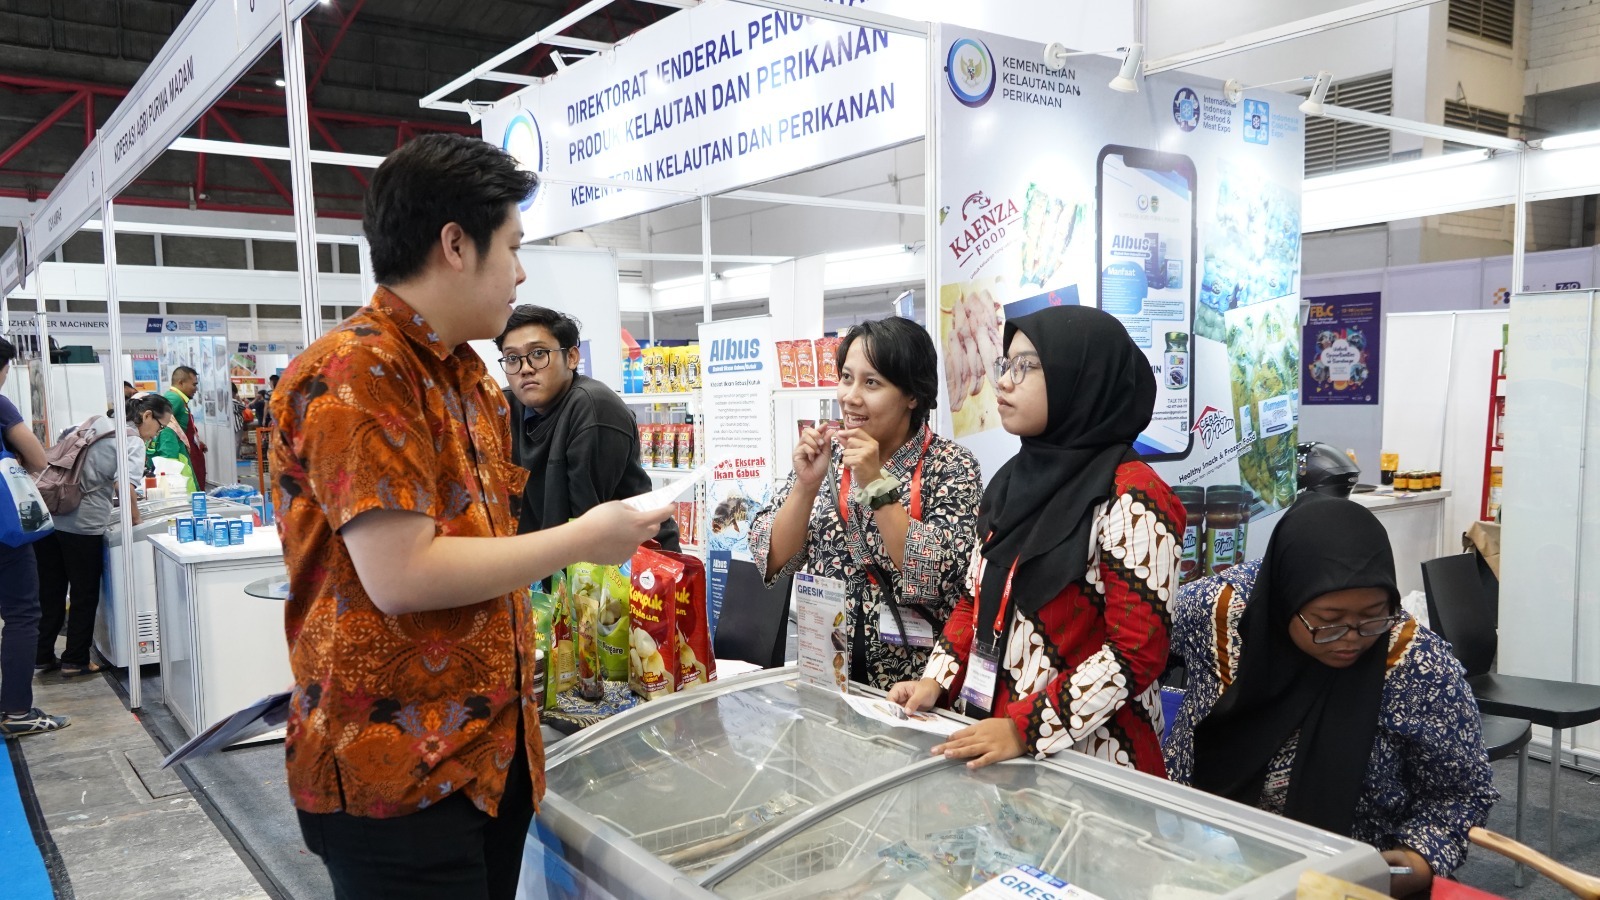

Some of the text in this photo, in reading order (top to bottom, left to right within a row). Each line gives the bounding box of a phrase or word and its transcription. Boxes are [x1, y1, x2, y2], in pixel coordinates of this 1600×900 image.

[569, 27, 888, 164] PRODUK KELAUTAN DAN PERIKANAN
[1002, 72, 1080, 96] KELAUTAN DAN
[113, 124, 136, 164] KOPERASI
[137, 109, 148, 140] AGRI
[169, 54, 194, 102] MADANI
[568, 69, 648, 127] DIREKTORAT
[1002, 88, 1062, 109] PERIKANAN
[1203, 103, 1232, 116] Indonesia
[1203, 112, 1226, 124] Seafood
[1203, 121, 1231, 133] Meat Expo
[657, 136, 732, 180] KELAUTAN
[738, 124, 772, 154] DAN
[778, 82, 896, 145] PERIKANAN
[949, 199, 1018, 260] KAENZA
[975, 227, 1006, 256] FOOD
[1112, 234, 1150, 250] Albus
[1107, 267, 1136, 276] Manfaat
[709, 338, 760, 362] Albus
[735, 457, 765, 467] Ekstrak
[1178, 466, 1202, 484] Healthy
[1202, 456, 1218, 469] Snack
[1224, 443, 1241, 456] Frozen
[1243, 434, 1256, 444] Food
[714, 469, 760, 480] Ikan Gabus
[797, 584, 824, 598] GRESIK
[1000, 875, 1064, 900] GRES
